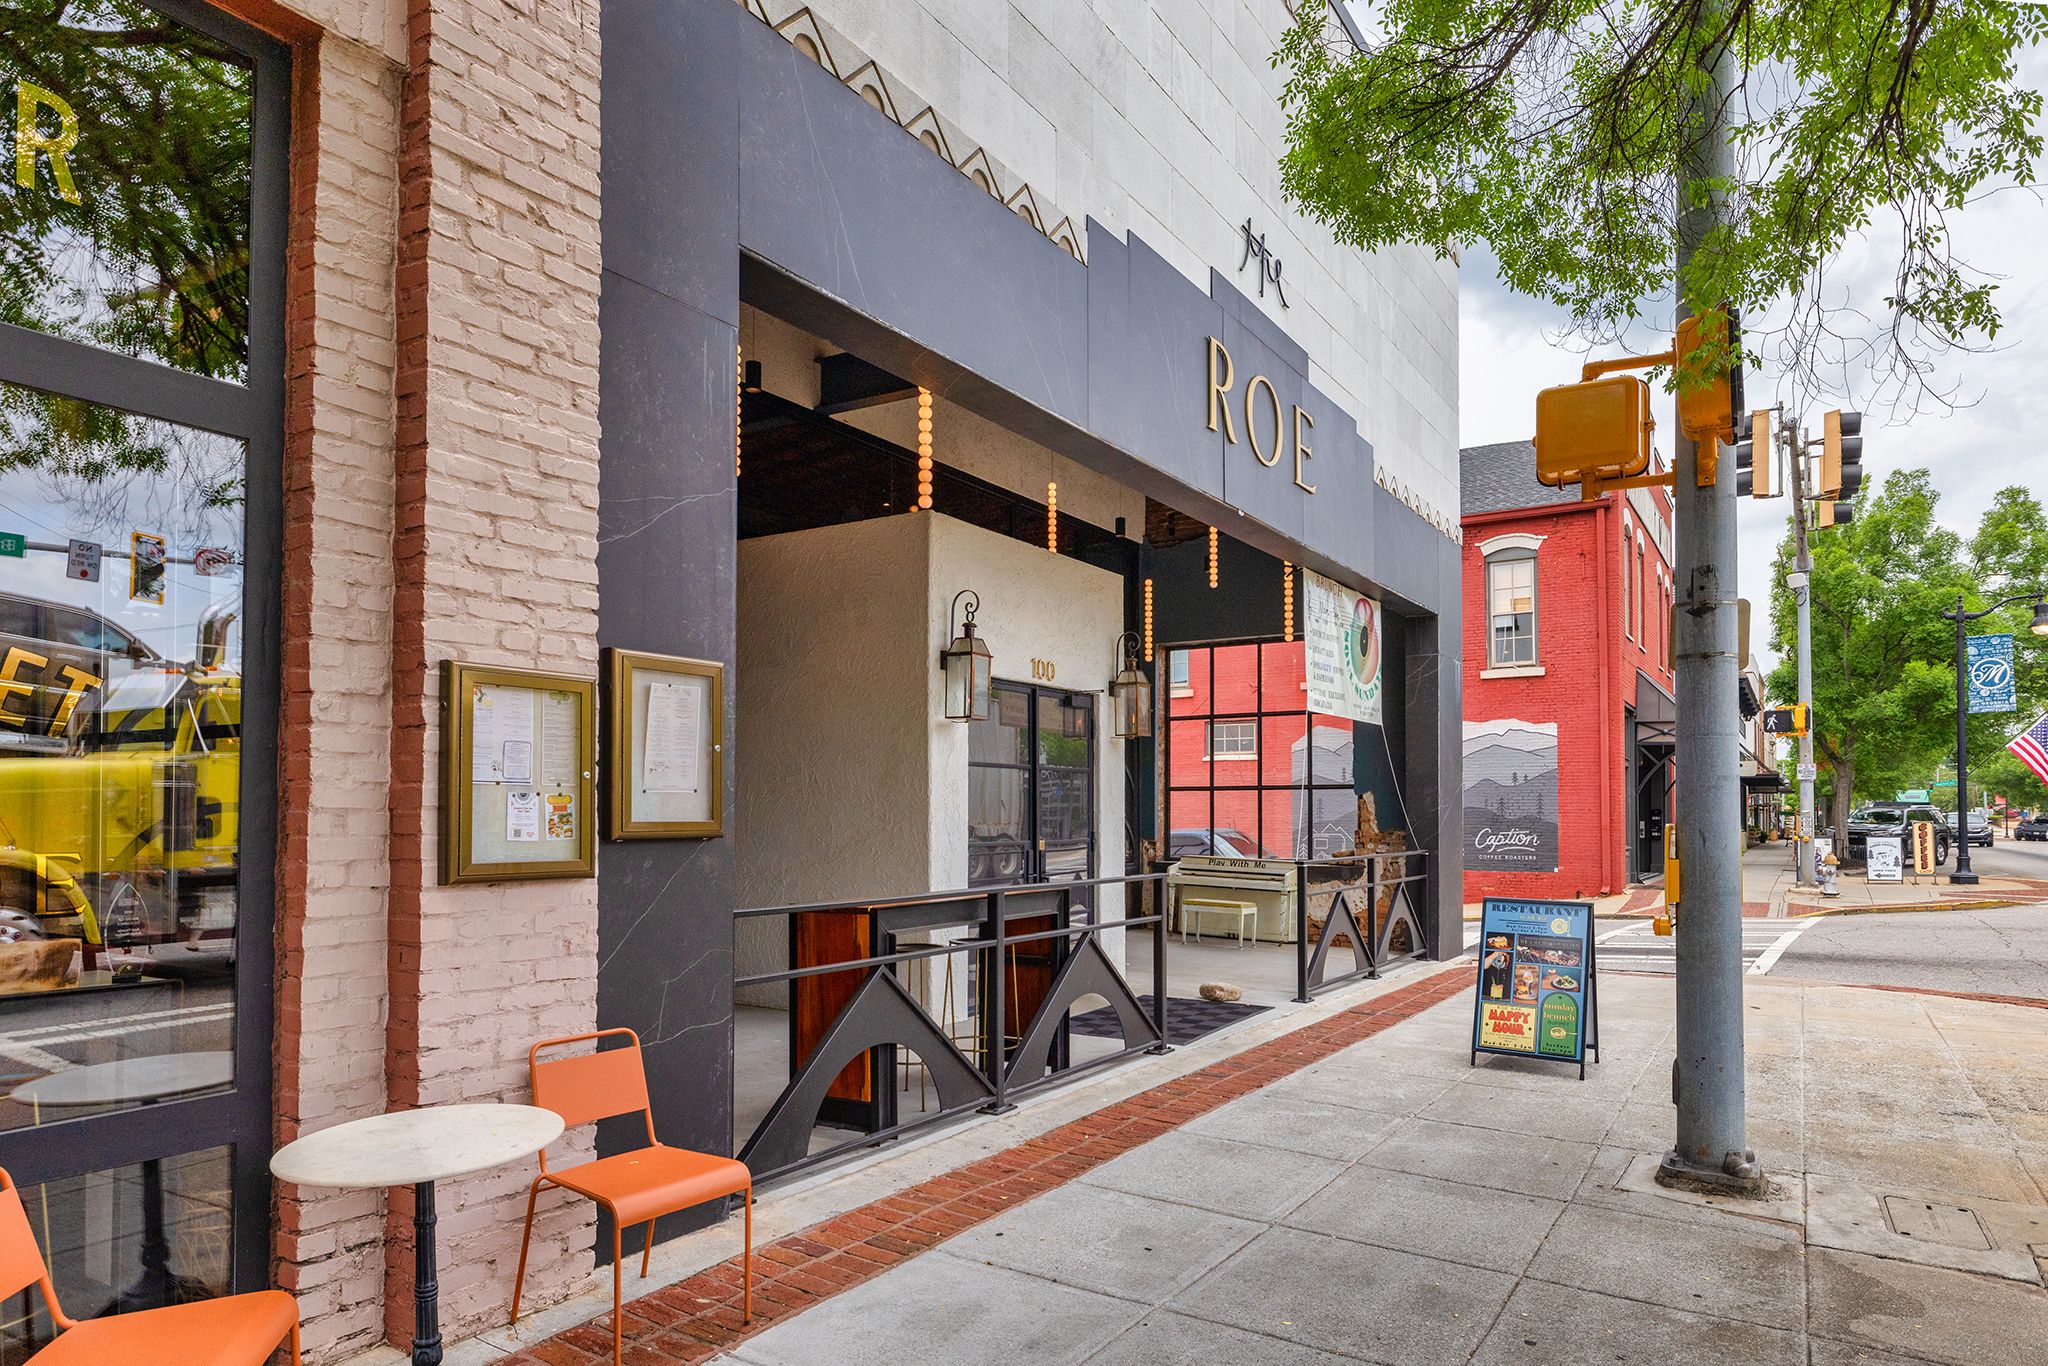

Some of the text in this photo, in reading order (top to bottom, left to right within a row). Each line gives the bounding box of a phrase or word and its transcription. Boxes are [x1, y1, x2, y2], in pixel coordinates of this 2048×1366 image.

[15, 80, 82, 206] R
[1206, 335, 1317, 494] ROE
[1315, 575, 1343, 597] BRUNCH
[1031, 657, 1056, 681] 100
[1475, 828, 1541, 853] Caption
[1918, 823, 1928, 869] COFFEE
[1208, 858, 1267, 869] Play With Me
[1491, 903, 1582, 918] RESTAURANT
[1488, 1009, 1531, 1024] HAPPY
[1543, 1011, 1576, 1022] brunch
[1492, 1021, 1525, 1035] HOUR
